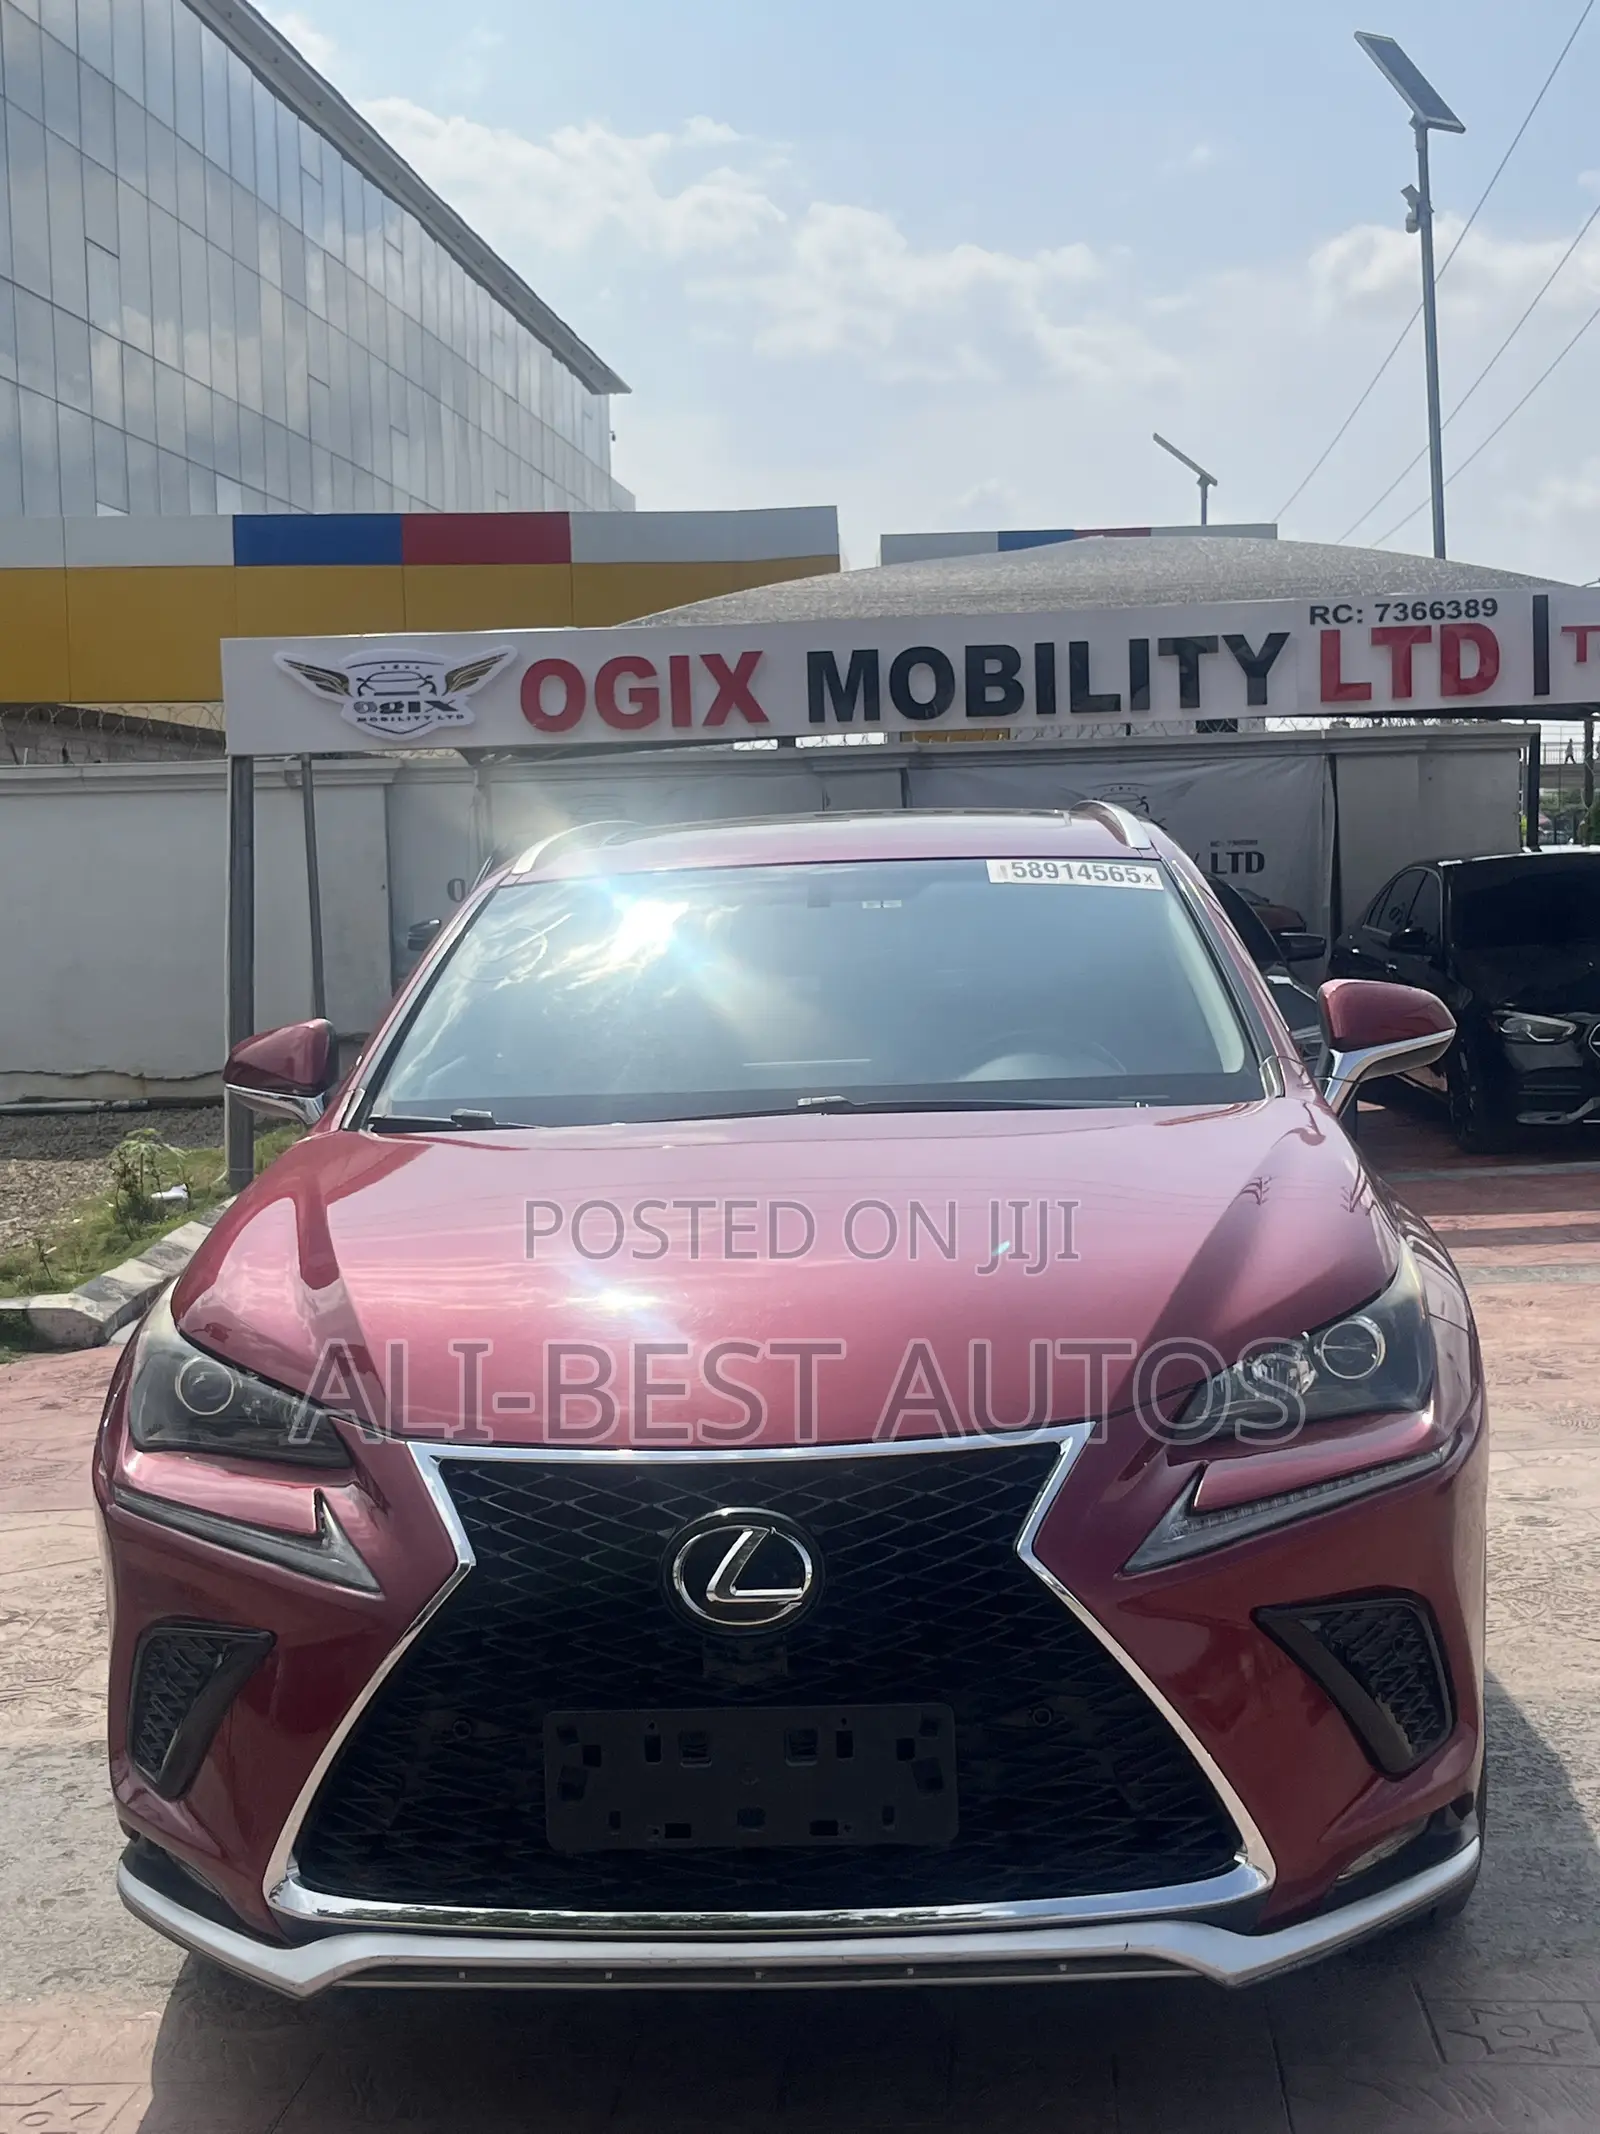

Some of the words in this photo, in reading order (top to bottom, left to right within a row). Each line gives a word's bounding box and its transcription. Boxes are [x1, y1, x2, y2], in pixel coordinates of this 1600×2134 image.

[1309, 604, 1363, 625] RC:
[1375, 598, 1498, 623] 7366389
[519, 650, 770, 733] OGIX
[806, 631, 1291, 724] MOBILITY
[1320, 622, 1500, 702] LTD
[1210, 851, 1265, 874] LTD
